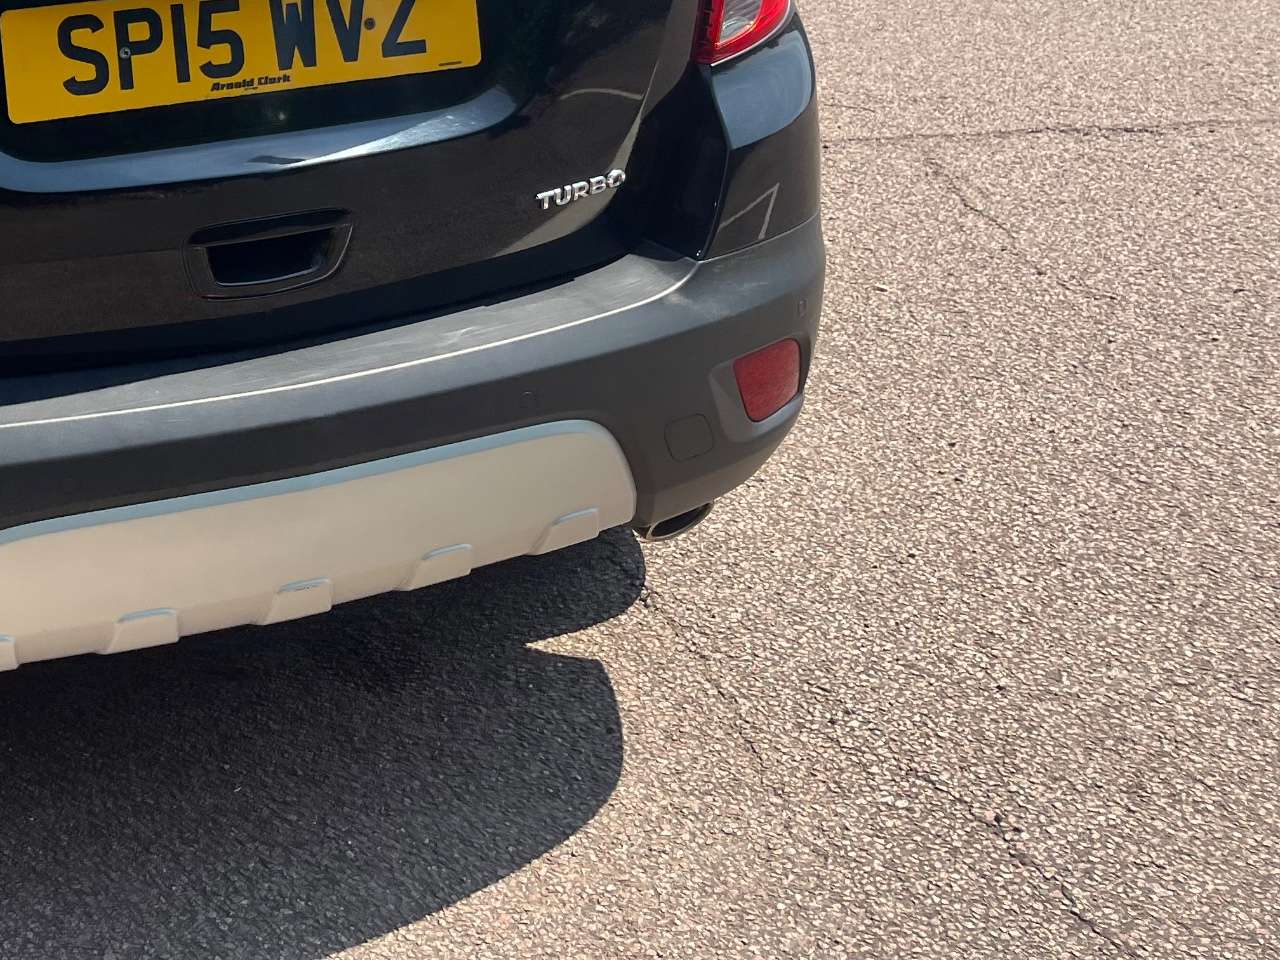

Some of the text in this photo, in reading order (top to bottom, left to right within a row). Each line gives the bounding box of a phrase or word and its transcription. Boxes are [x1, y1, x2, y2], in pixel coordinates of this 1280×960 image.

[210, 73, 291, 91] Arnold Clark
[535, 169, 626, 210] TURBO
